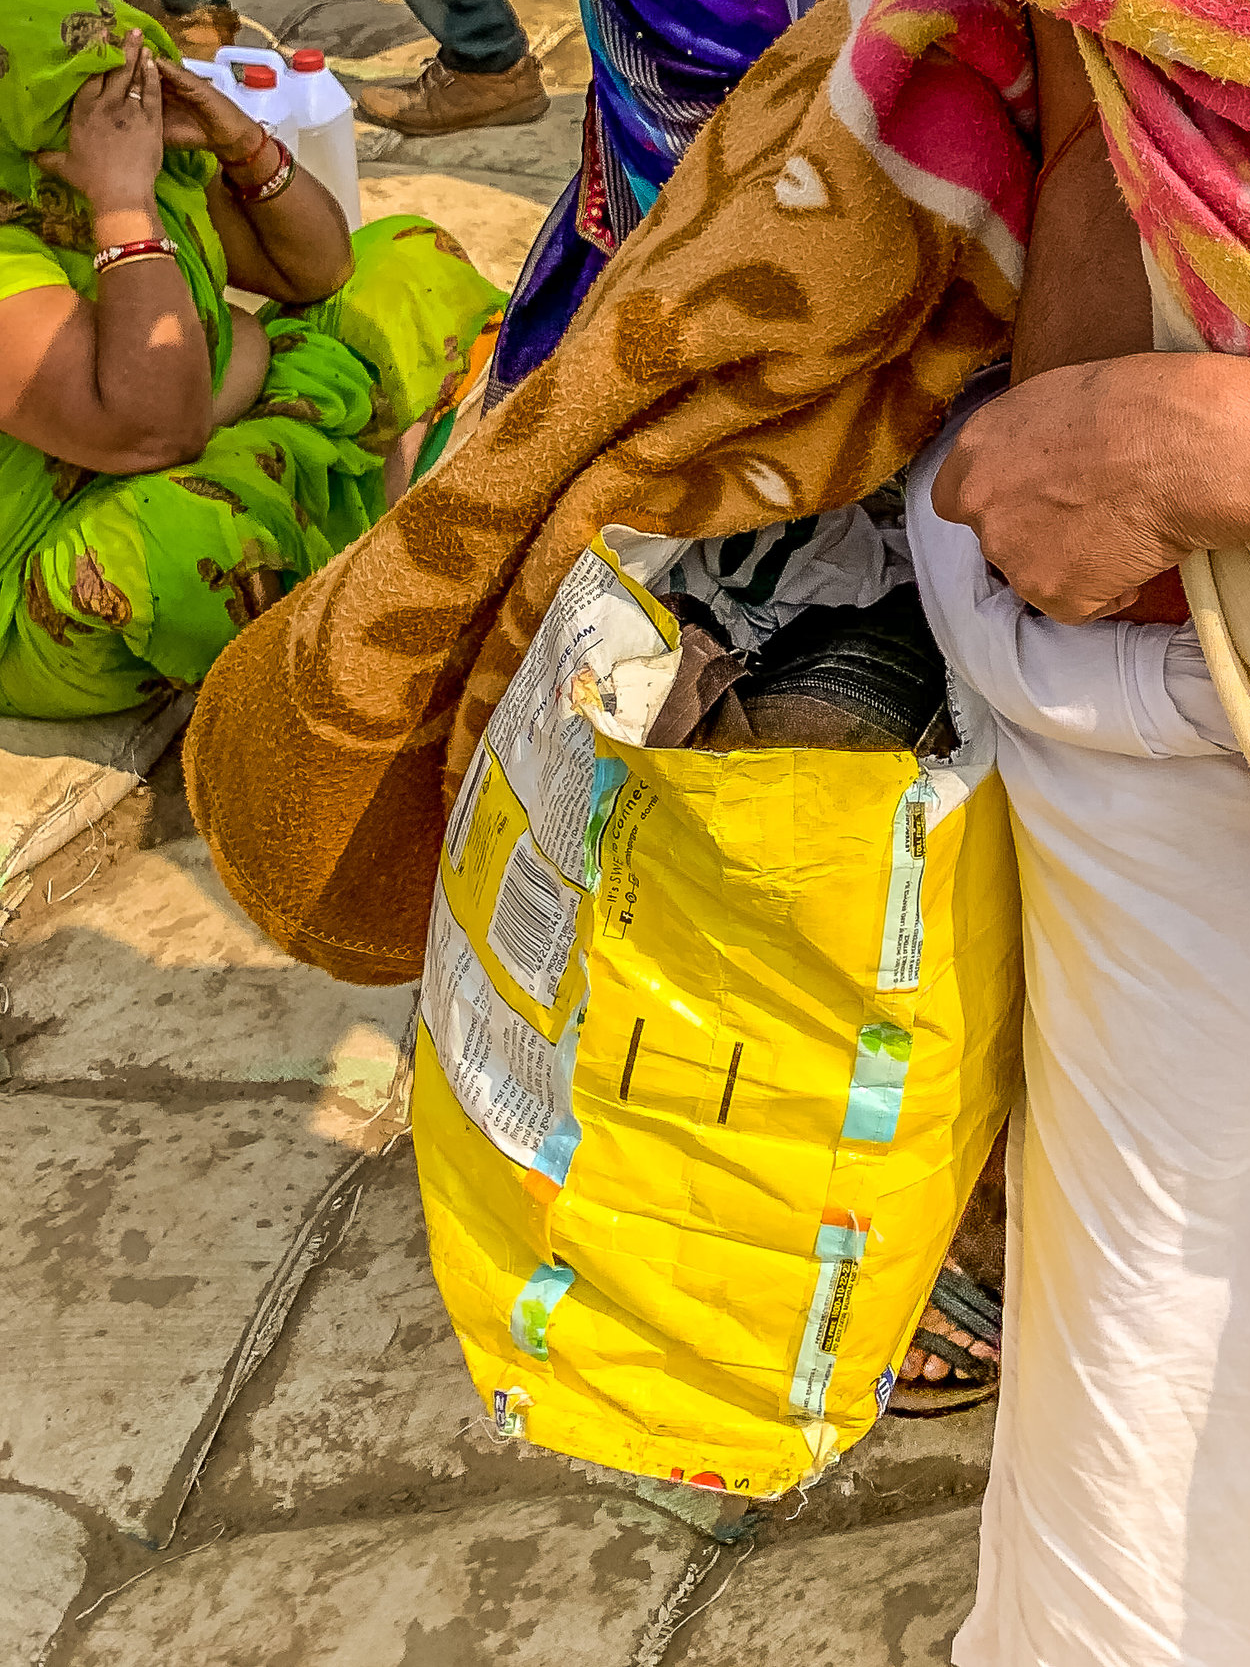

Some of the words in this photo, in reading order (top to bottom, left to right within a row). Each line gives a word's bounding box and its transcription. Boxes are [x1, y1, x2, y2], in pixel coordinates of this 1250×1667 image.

[570, 625, 596, 646] JAM
[474, 1044, 491, 1072] before
[483, 1107, 494, 1119] To
[491, 1089, 505, 1107] test
[500, 1073, 514, 1089] the
[513, 1090, 528, 1109] and
[526, 1111, 538, 1129] you
[534, 1050, 545, 1070] then
[492, 1098, 511, 1126] center
